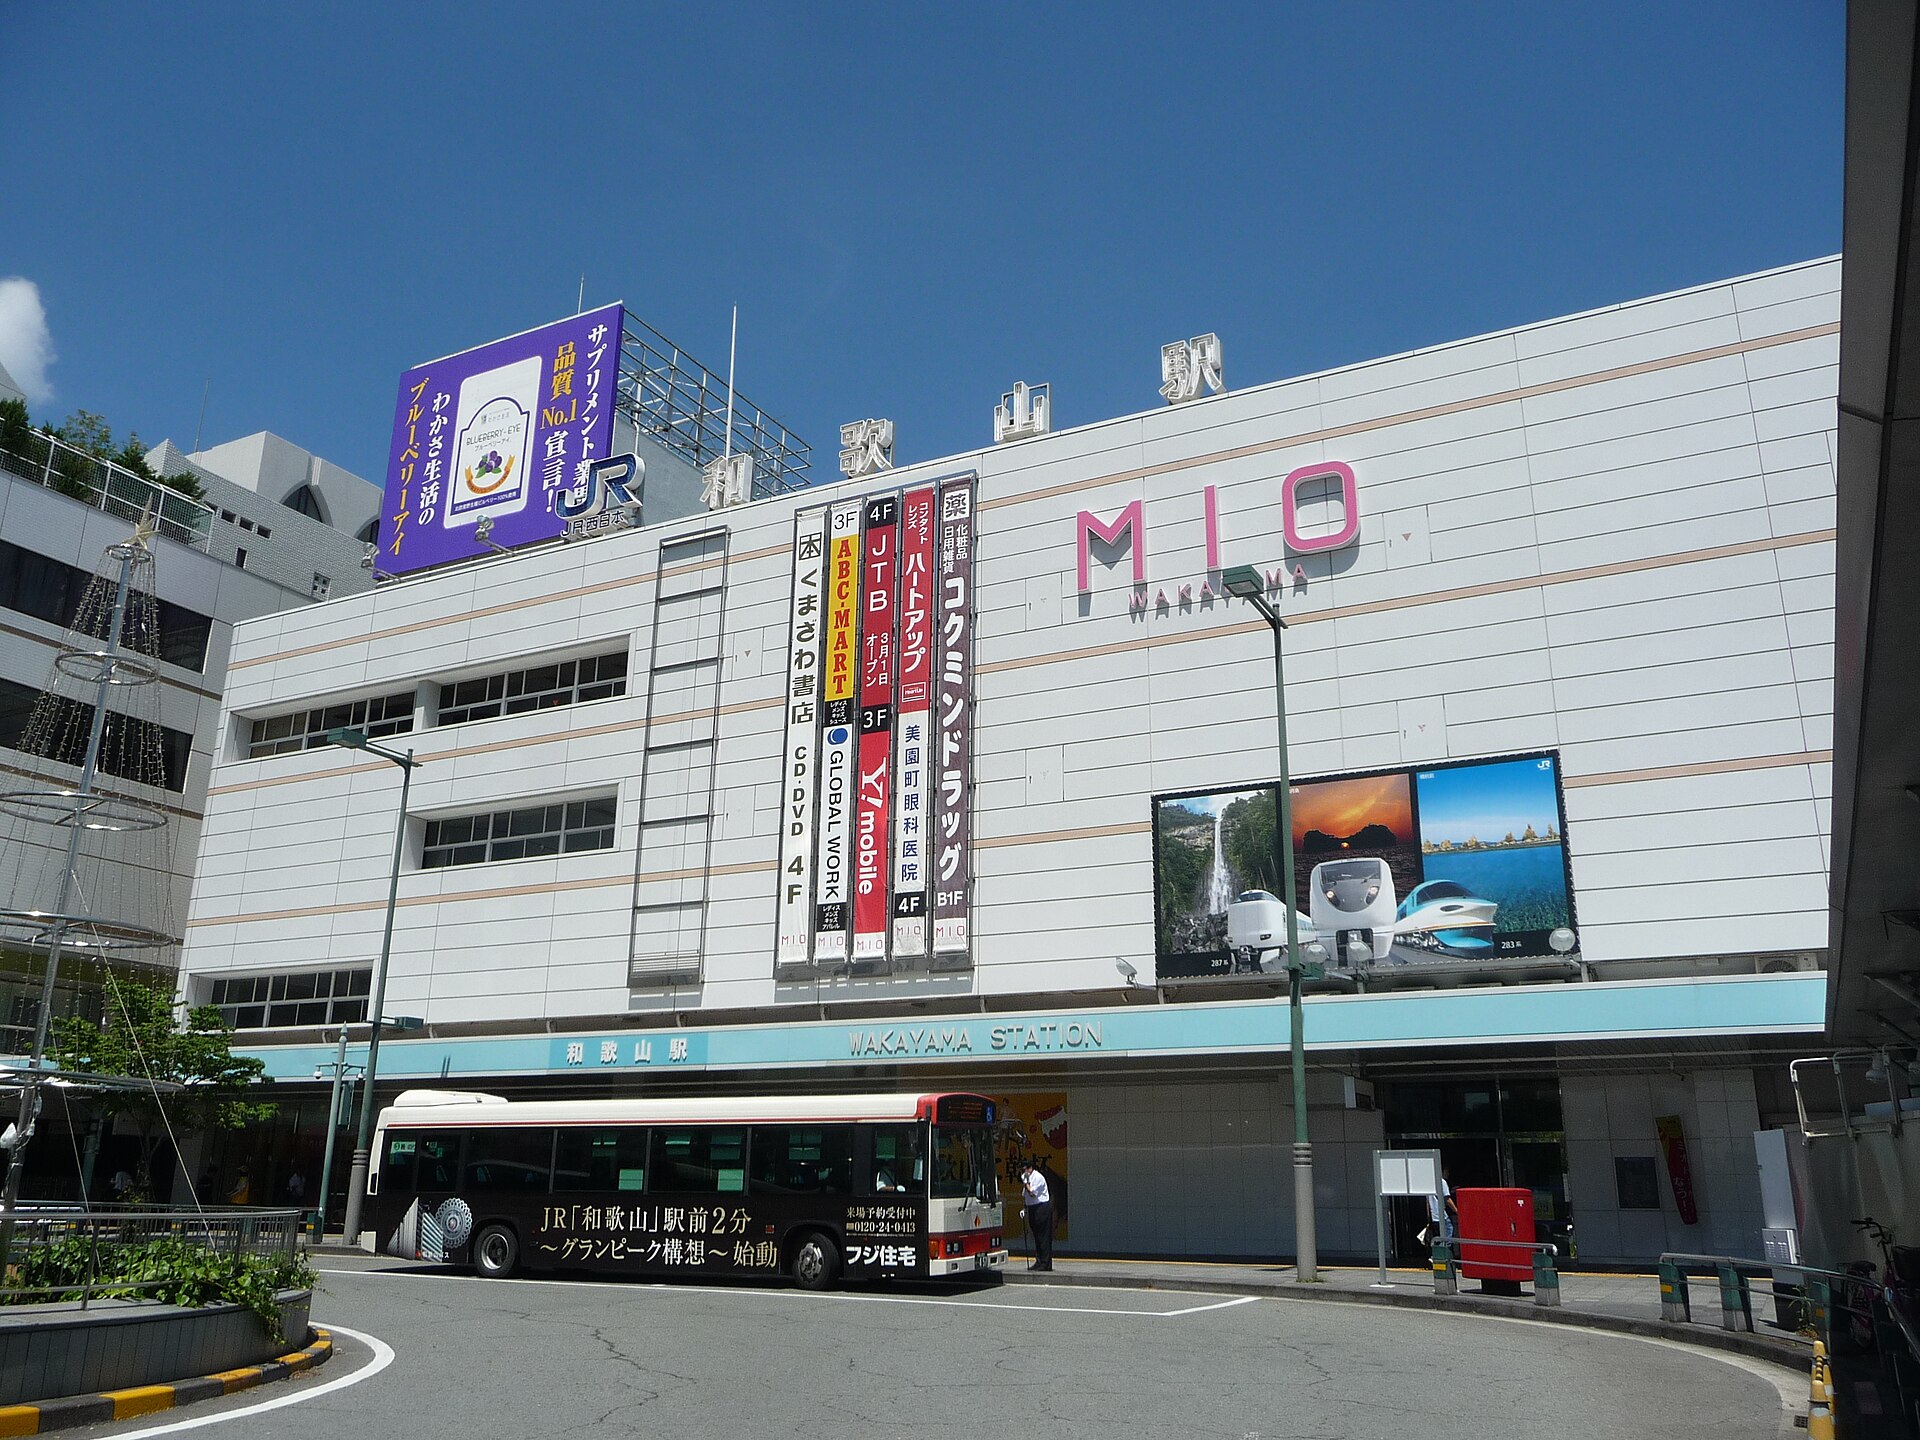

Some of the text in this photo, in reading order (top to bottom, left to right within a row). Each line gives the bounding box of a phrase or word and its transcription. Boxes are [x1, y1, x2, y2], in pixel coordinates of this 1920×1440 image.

[700, 332, 1226, 510] 和歌山駅
[388, 377, 430, 557] ブルーベリーアイ
[417, 392, 451, 526] わかさ生活の
[555, 452, 645, 520] JR
[561, 510, 626, 537] JR西日本
[834, 511, 857, 530] 3F
[870, 503, 893, 522] 4F
[907, 505, 917, 530] レンズ
[919, 502, 928, 545] コンタクト
[946, 493, 967, 518] 薬
[956, 523, 968, 560] 化粧品
[1076, 460, 1359, 592] MIO
[799, 532, 822, 561] 本
[943, 526, 955, 575] 日用雑貨
[869, 534, 889, 613] JTB
[1129, 563, 1309, 610] WAKAMA
[903, 552, 926, 674] ハートアップ
[791, 568, 818, 725] くまざわ書店
[865, 634, 878, 688] オープン
[878, 633, 889, 685] 3月1日
[863, 709, 887, 728] 3F
[937, 577, 965, 907] コクミンドラッグ B1F
[1537, 760, 1551, 768] JR
[826, 750, 844, 899] GLOBAL WORK
[898, 724, 921, 913] 美園町眼科医院 4F
[787, 855, 804, 905] 4F
[781, 934, 806, 946] MIO
[818, 936, 844, 947] MIO
[857, 940, 883, 950] MIO
[896, 925, 921, 937] MIO
[936, 925, 965, 938] MIO
[567, 1038, 688, 1065] 和歌山駅
[849, 1021, 1102, 1056] WAKAYAMA STATION
[540, 1205, 752, 1235] JR「和歌山」駅前2分
[846, 1245, 916, 1267] フジ住宅
